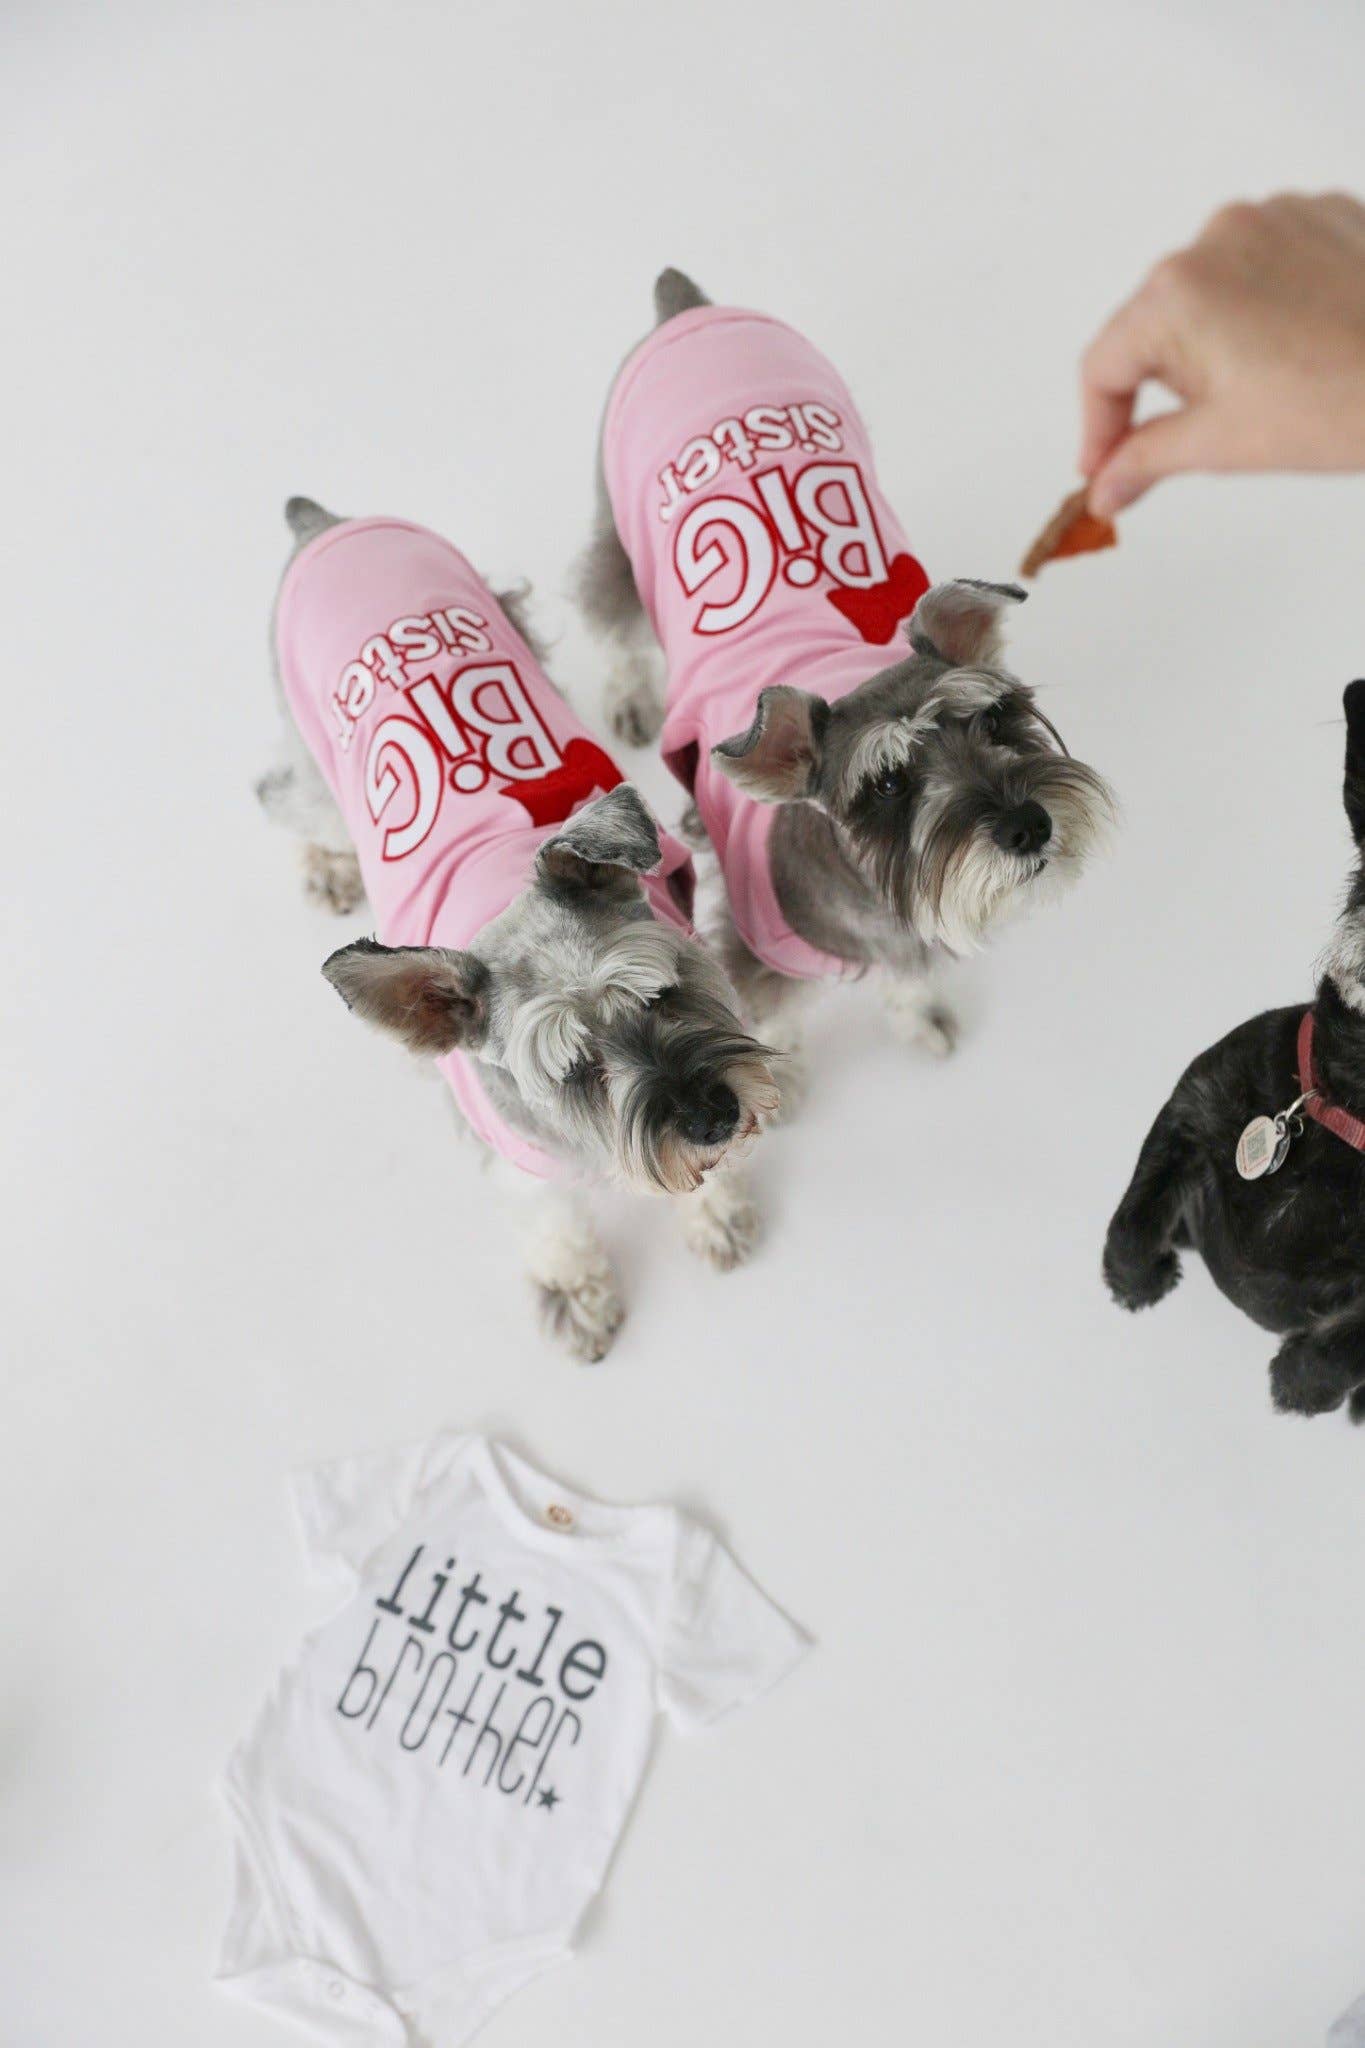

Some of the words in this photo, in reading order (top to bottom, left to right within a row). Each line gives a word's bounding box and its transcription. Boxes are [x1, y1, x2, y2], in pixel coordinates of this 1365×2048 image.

[657, 402, 846, 523] sister
[331, 606, 492, 751] sister
[375, 1545, 608, 1701] little
